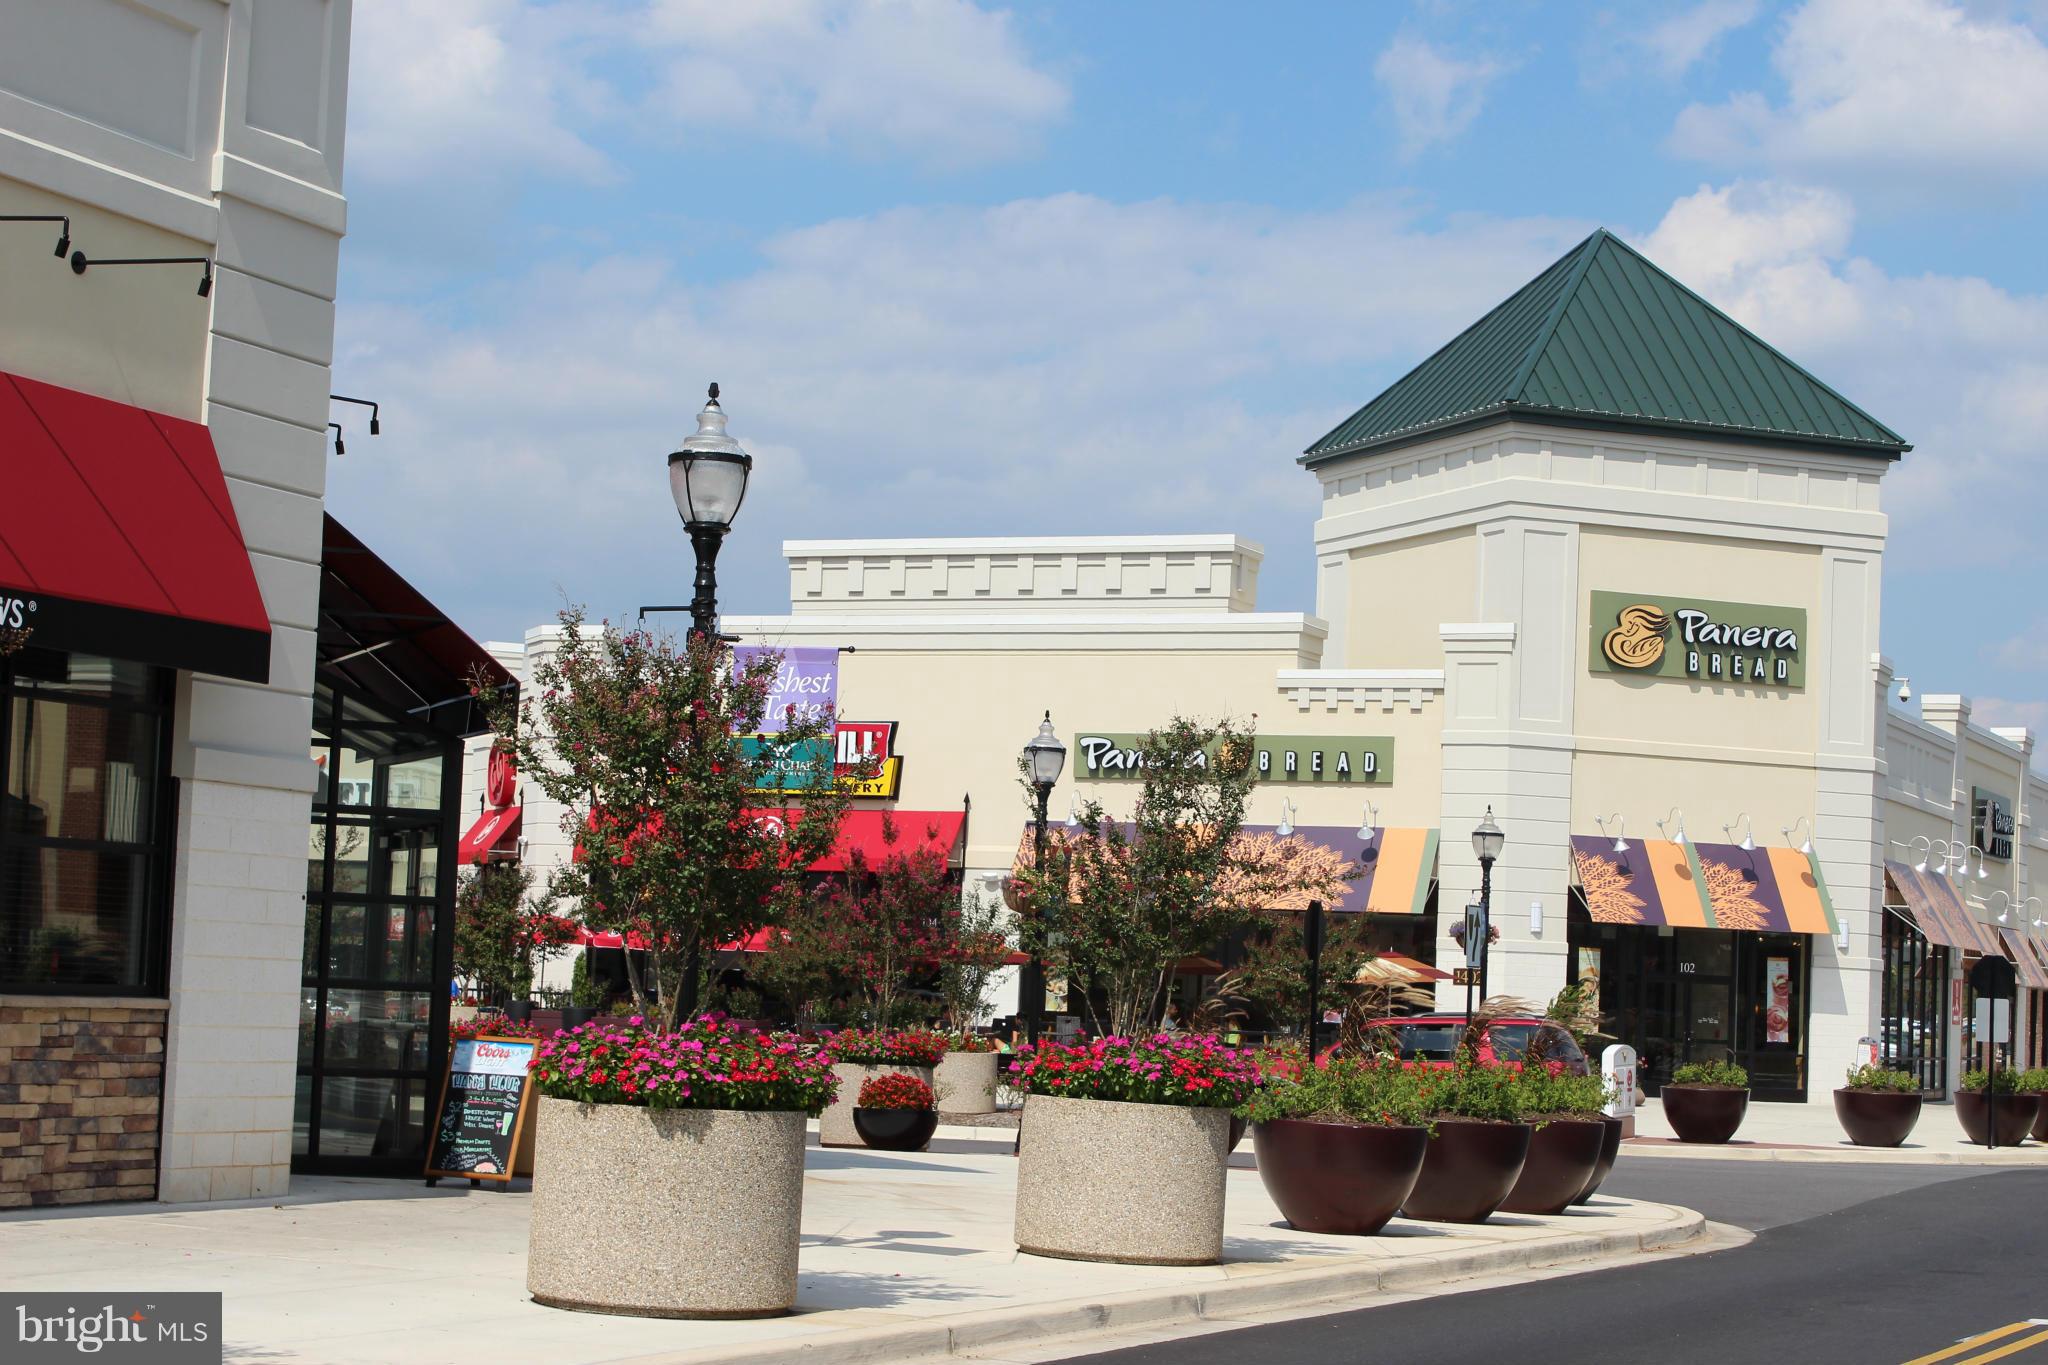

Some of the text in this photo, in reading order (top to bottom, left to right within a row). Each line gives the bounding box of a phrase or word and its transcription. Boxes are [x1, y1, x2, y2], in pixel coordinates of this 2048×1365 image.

[1678, 609, 1798, 650] Panera
[1689, 651, 1787, 679] BREAD
[834, 731, 880, 764] ILL
[1080, 737, 1375, 772] Pana BREAD
[1679, 962, 1696, 973] 102
[476, 1043, 511, 1059] Coors
[489, 1074, 521, 1092] HOUR
